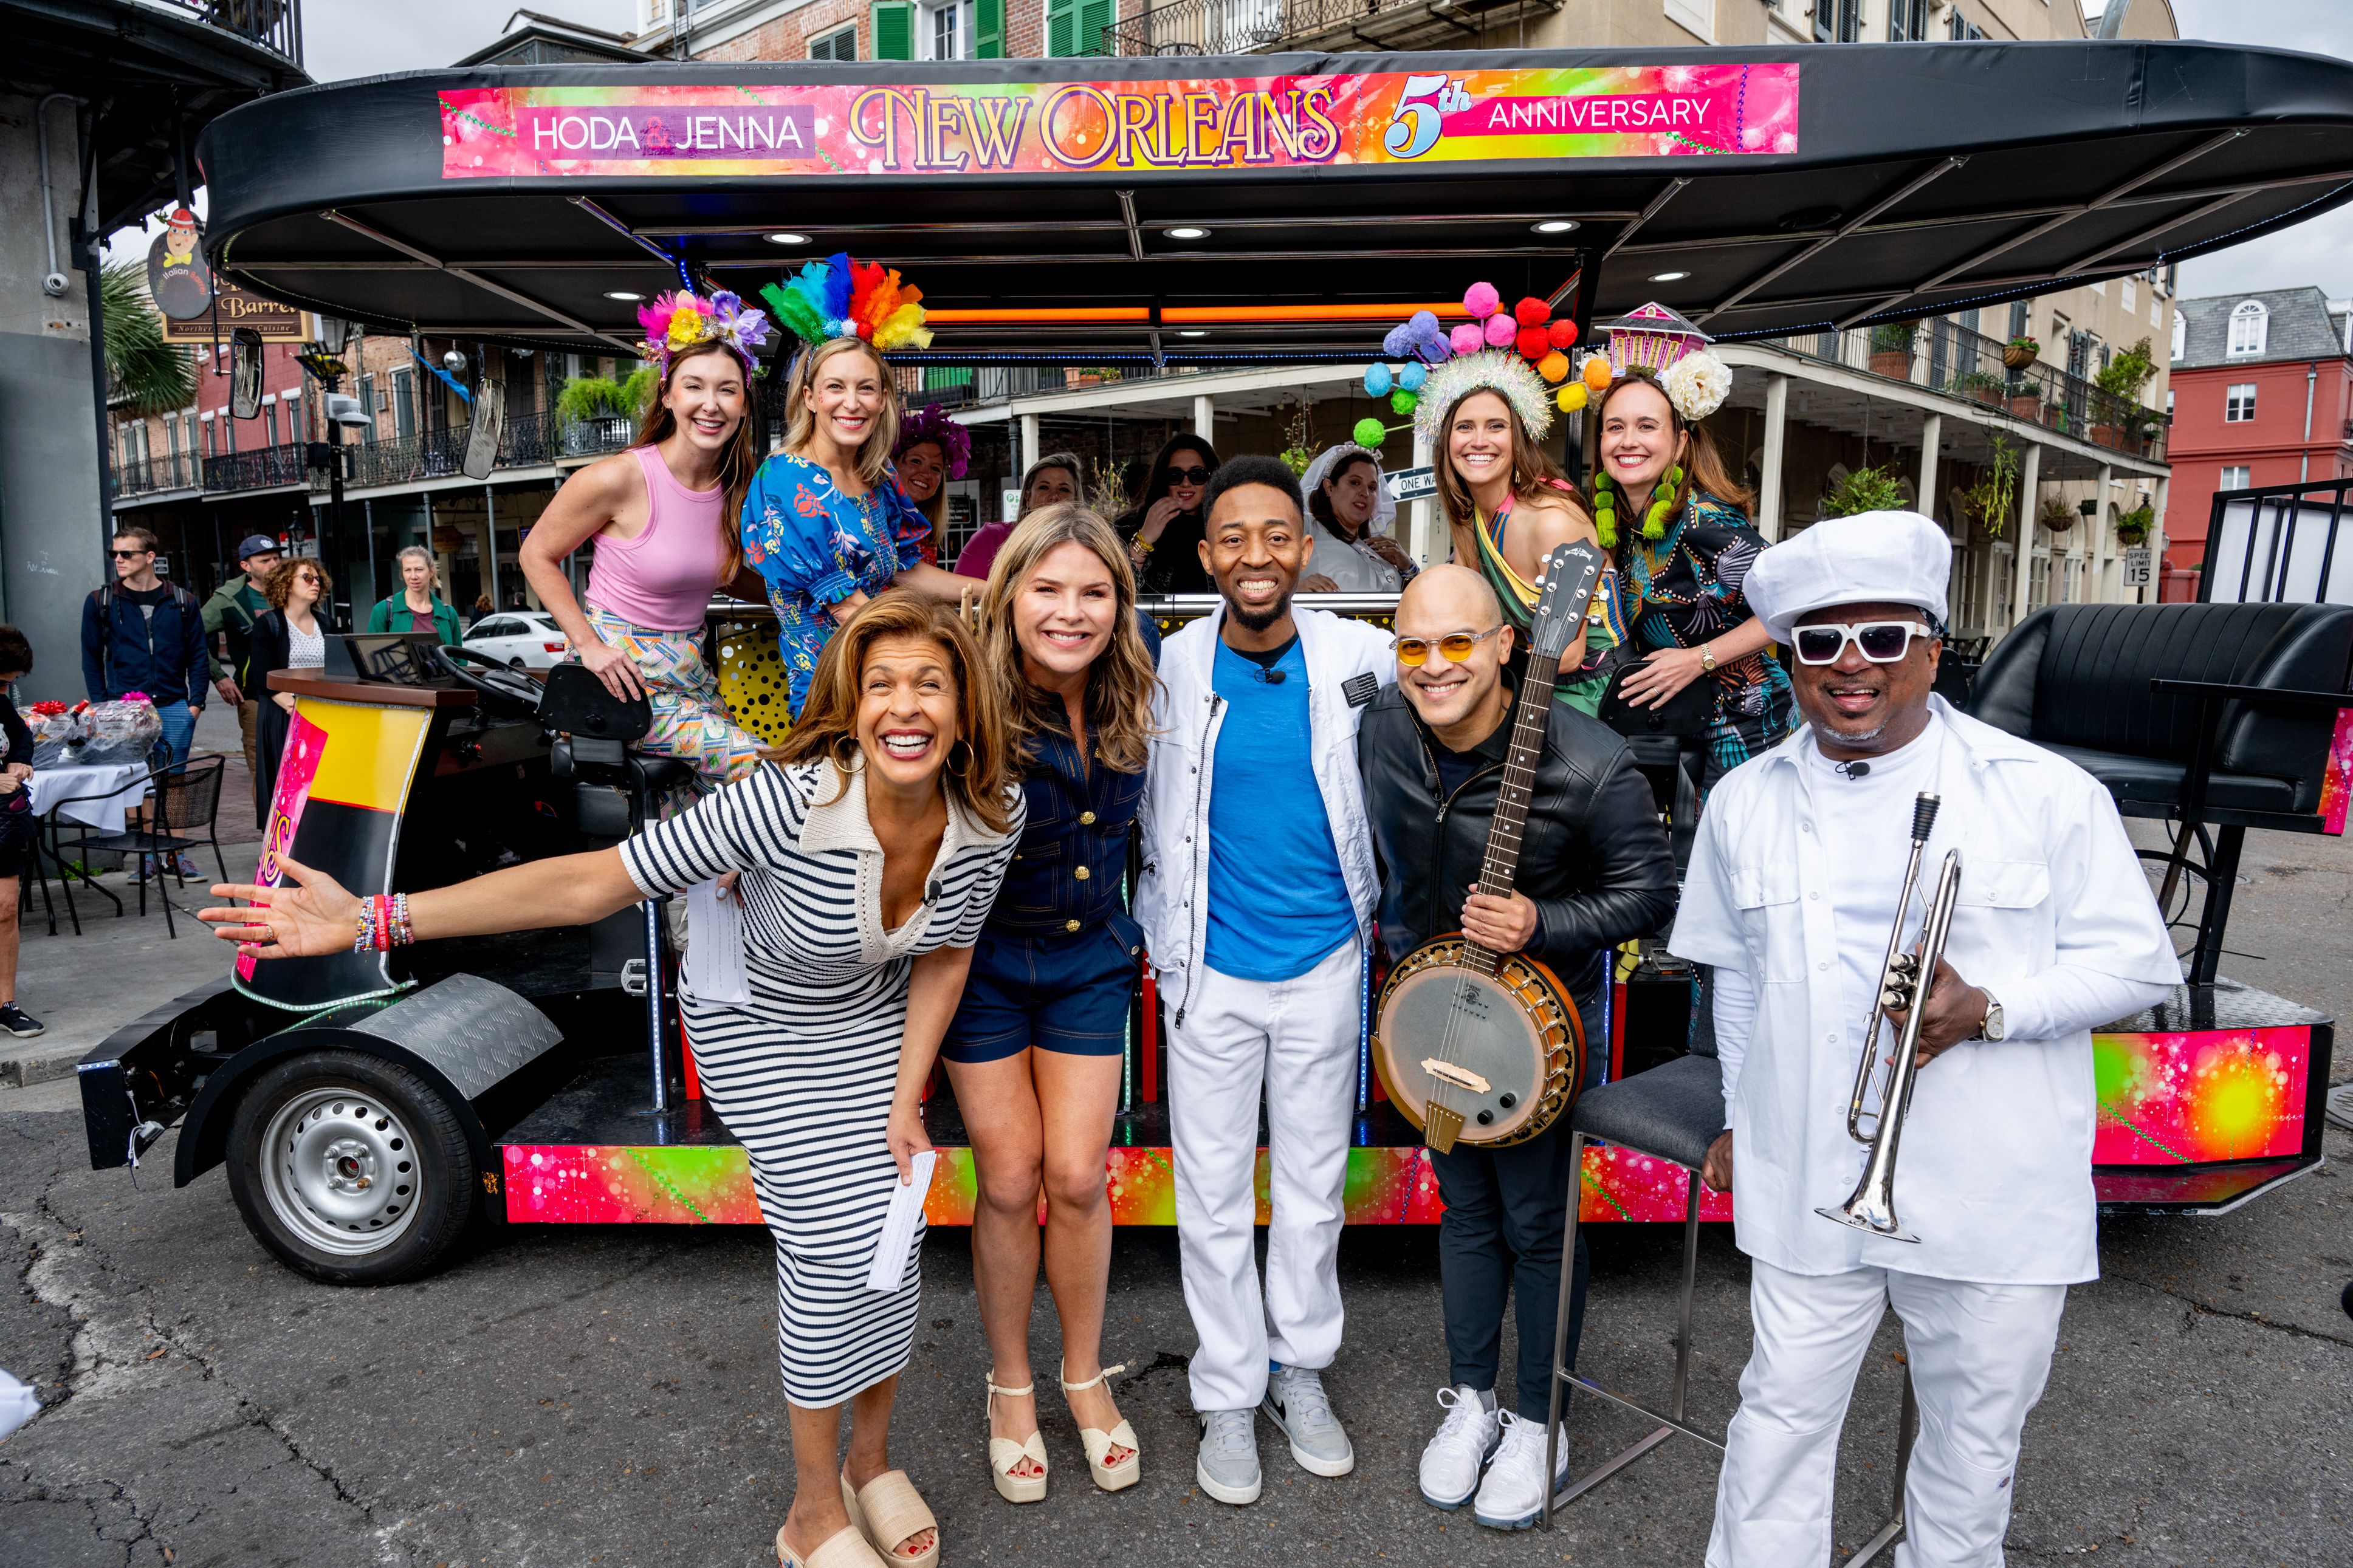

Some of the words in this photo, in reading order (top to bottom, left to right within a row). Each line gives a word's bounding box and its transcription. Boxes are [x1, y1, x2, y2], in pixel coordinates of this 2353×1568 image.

[849, 86, 1032, 171] NEW
[1040, 84, 1341, 170] ORLEANS
[1383, 74, 1472, 159] 5th
[1488, 98, 1711, 129] ANNIVERSARY
[534, 115, 638, 151] HODA
[646, 117, 670, 151] &
[675, 115, 803, 151] JENNA
[163, 267, 188, 279] Italian
[190, 271, 207, 296] Barrel
[1401, 477, 1420, 491] ONE
[2131, 568, 2149, 582] 15
